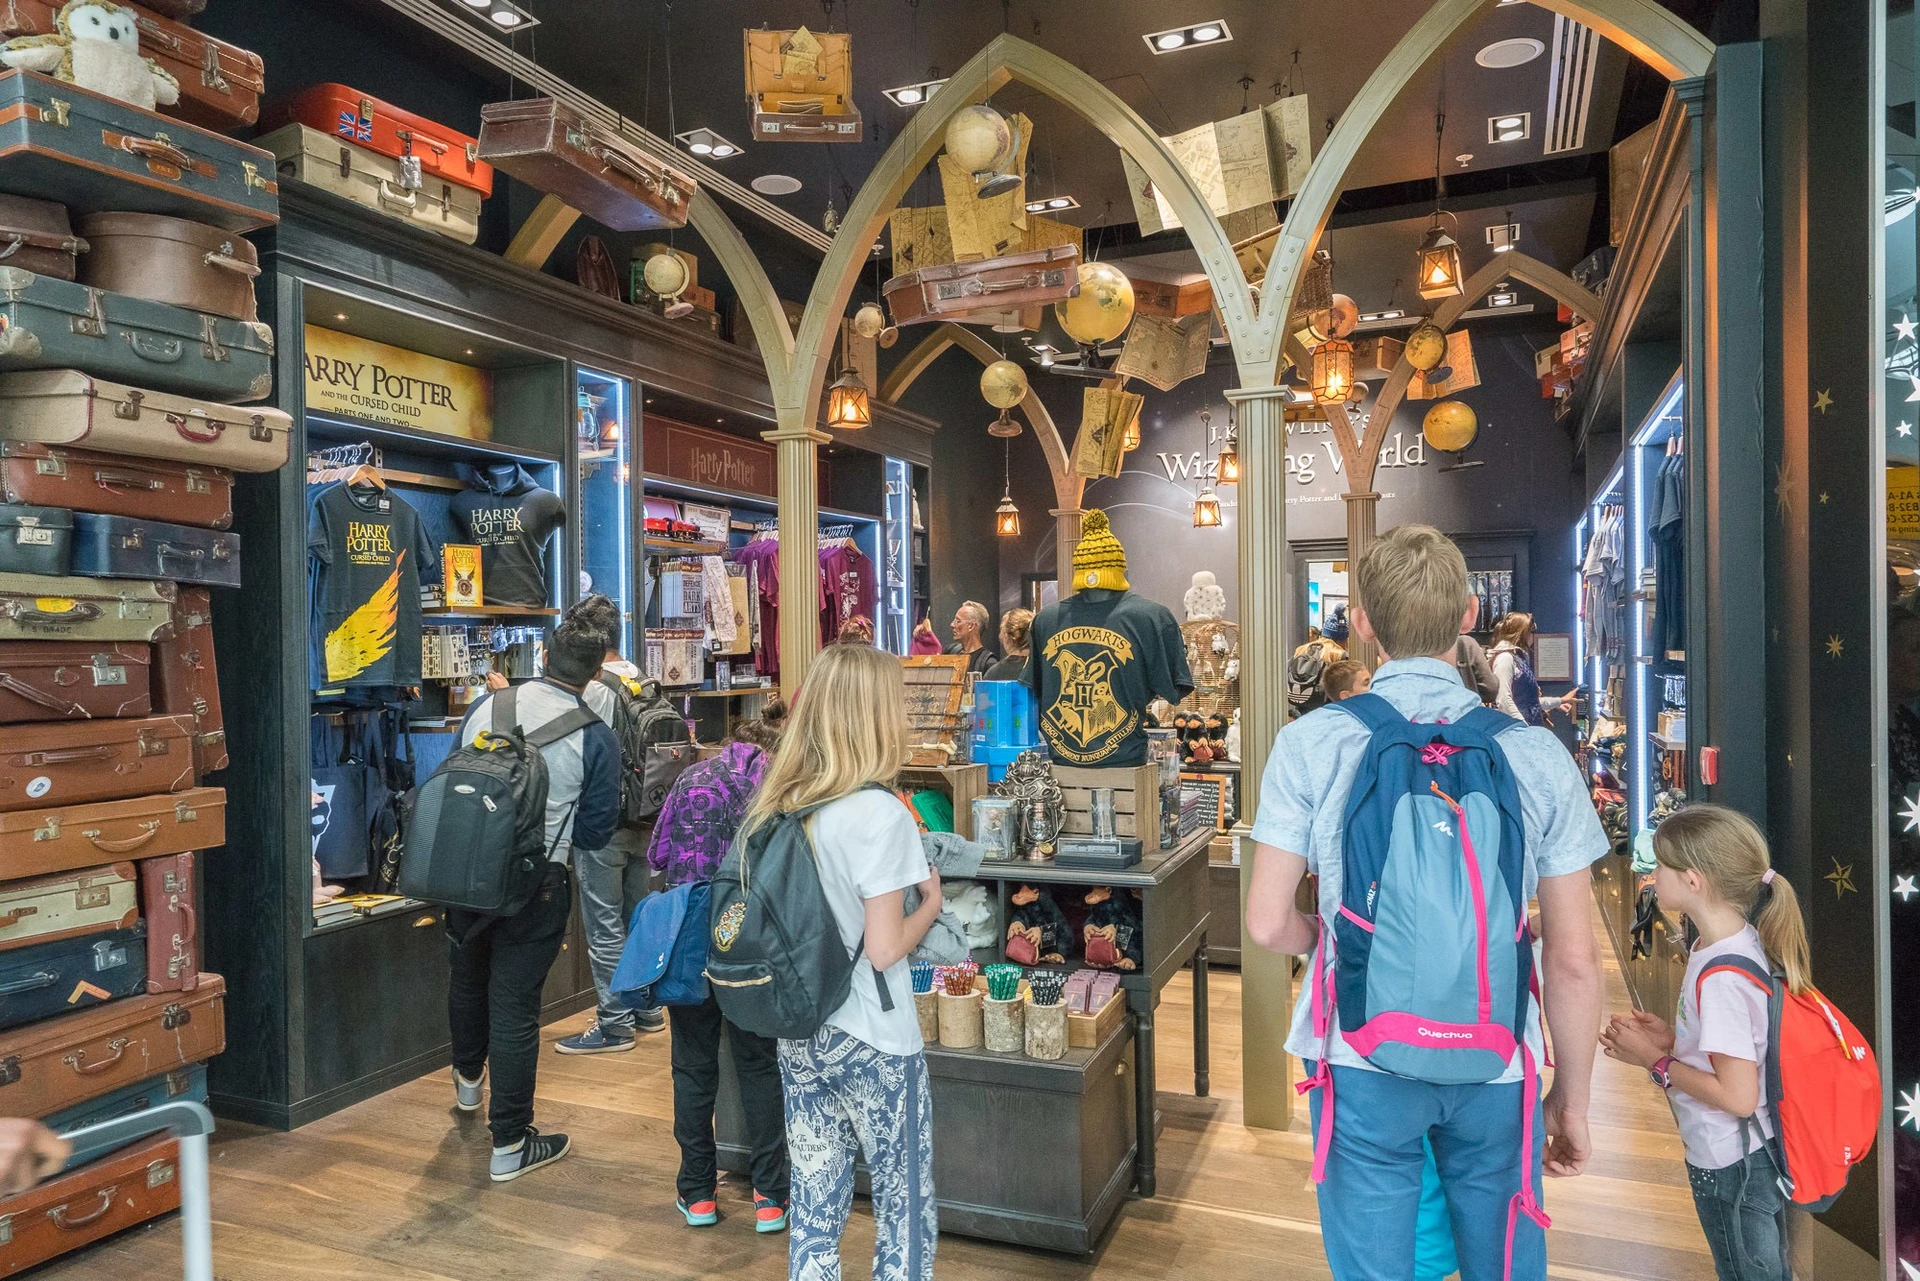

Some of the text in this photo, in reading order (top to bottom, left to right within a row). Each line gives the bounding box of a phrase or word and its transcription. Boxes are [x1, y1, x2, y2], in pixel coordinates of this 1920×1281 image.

[305, 352, 458, 411] ARRY POTTER
[320, 390, 421, 417] AND THE CURSED CHILD
[334, 406, 410, 427] PARTS ONE AND TWO
[1210, 426, 1238, 444] J.K
[690, 447, 756, 487] Harry Potter
[1157, 432, 1427, 483] Wizng Wrld
[470, 507, 524, 523] HARRY
[349, 522, 391, 539] HARRY
[346, 536, 395, 554] POTTER
[452, 548, 475, 557] HARRY
[451, 555, 477, 565] POTTER
[1053, 628, 1127, 650] HOGWARTS
[1076, 685, 1092, 706] H
[1417, 1026, 1473, 1039] Quechua
